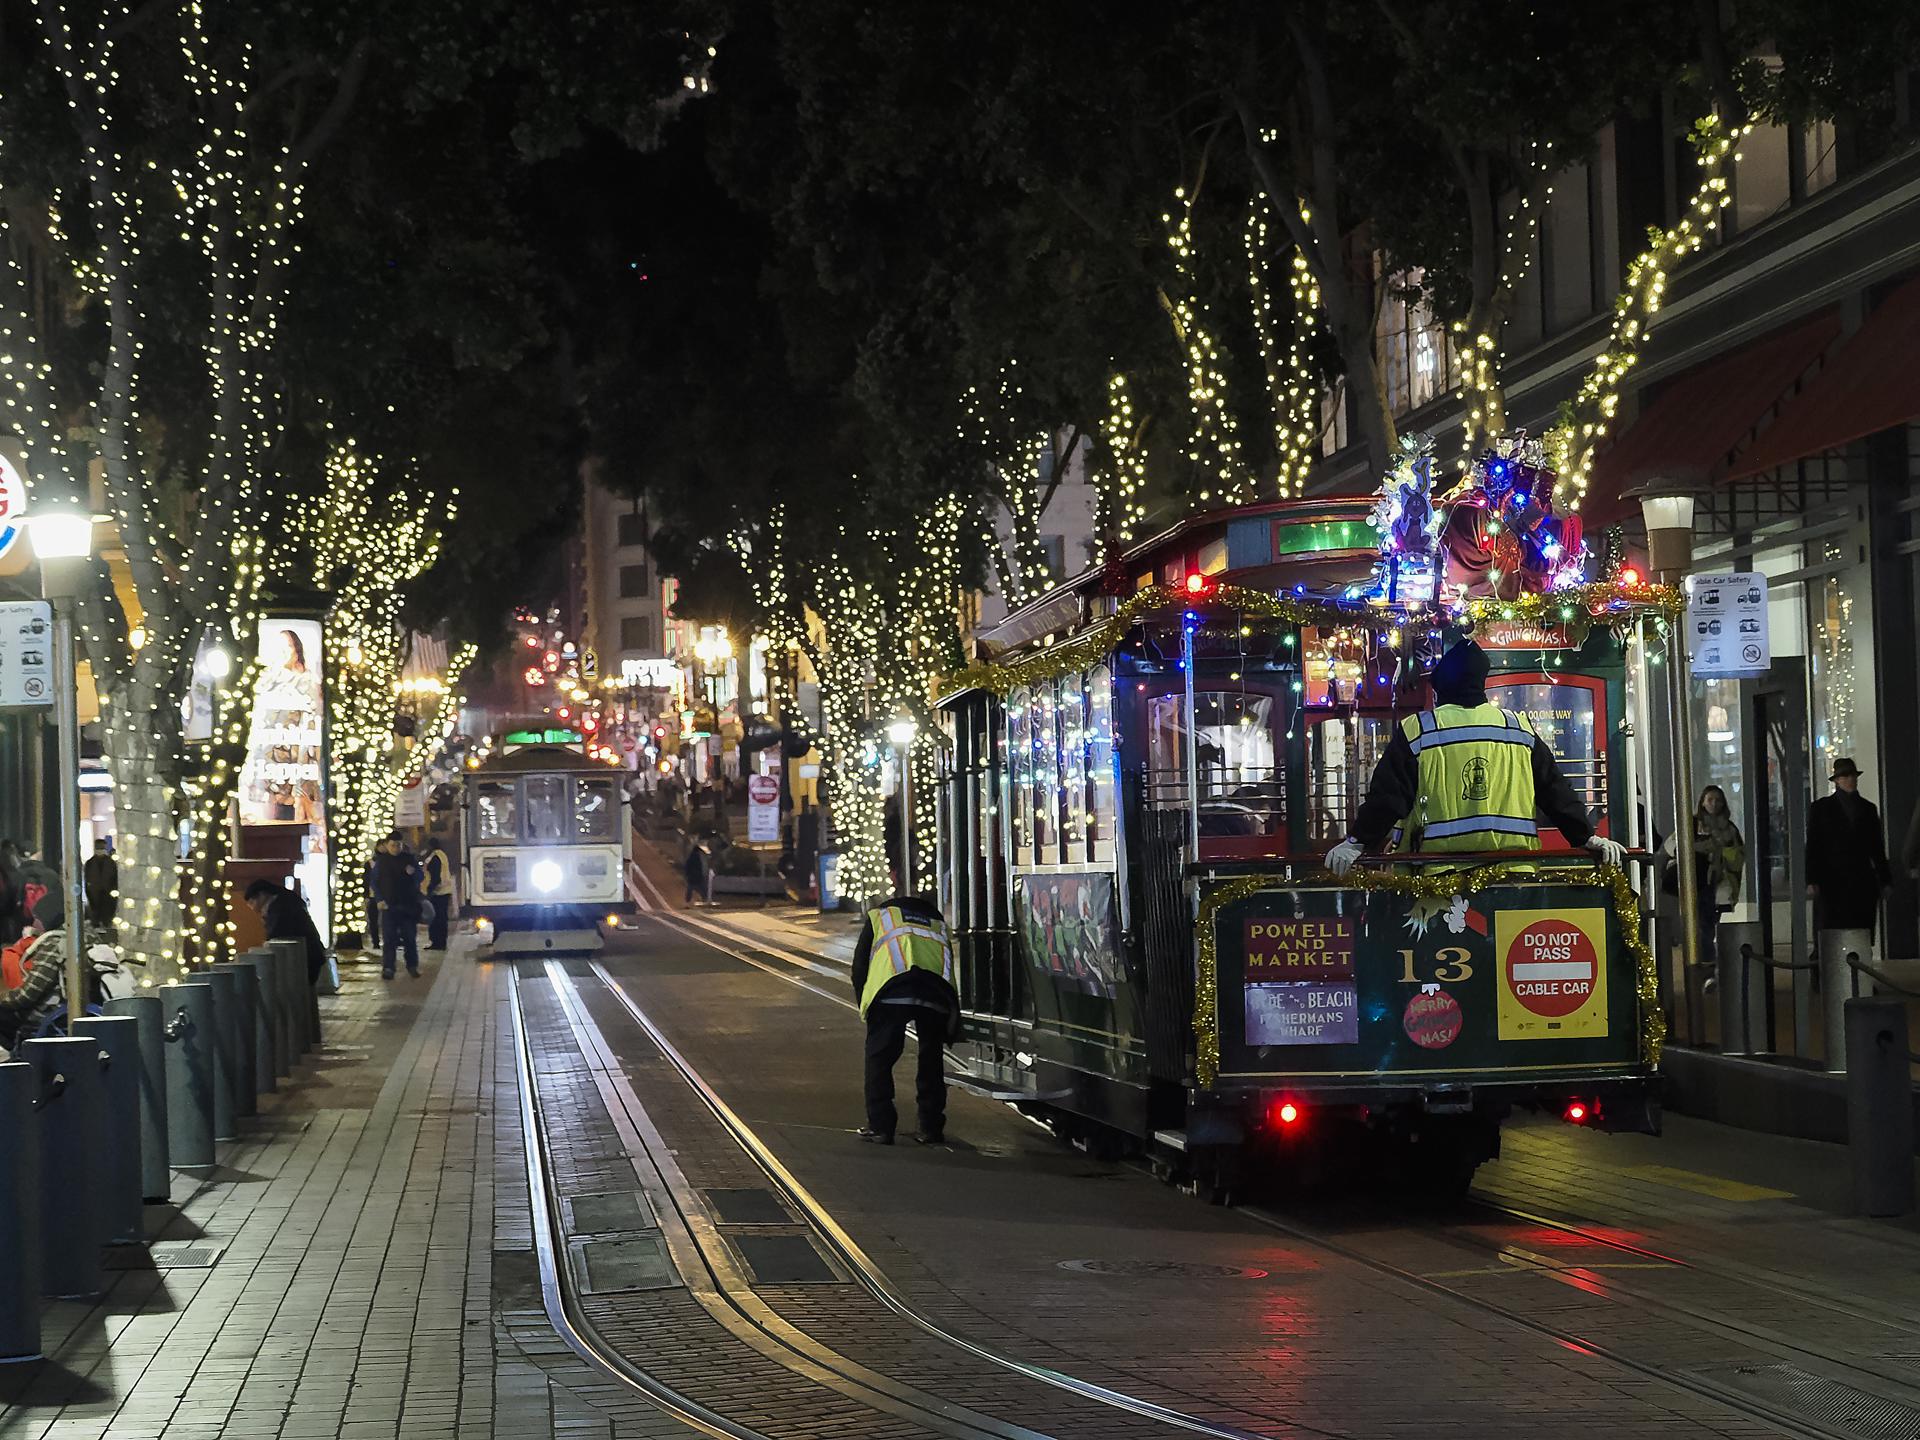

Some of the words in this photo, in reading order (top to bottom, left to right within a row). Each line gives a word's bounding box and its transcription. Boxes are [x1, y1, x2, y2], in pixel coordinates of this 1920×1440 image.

[1693, 577, 1711, 585] able
[1727, 576, 1752, 586] Safety
[1555, 709, 1572, 720] WAY
[1250, 923, 1350, 939] POWELL
[1277, 938, 1326, 951] AND
[1524, 933, 1547, 947] DO
[1549, 932, 1580, 946] NOT
[1249, 951, 1352, 967] MARKET
[1533, 946, 1572, 961] PASS
[1396, 946, 1474, 983] 13
[1516, 982, 1559, 996] CABLE
[1562, 981, 1590, 995] CAR
[1308, 991, 1353, 1009] BEACH
[1260, 1011, 1344, 1025] FHERMANS
